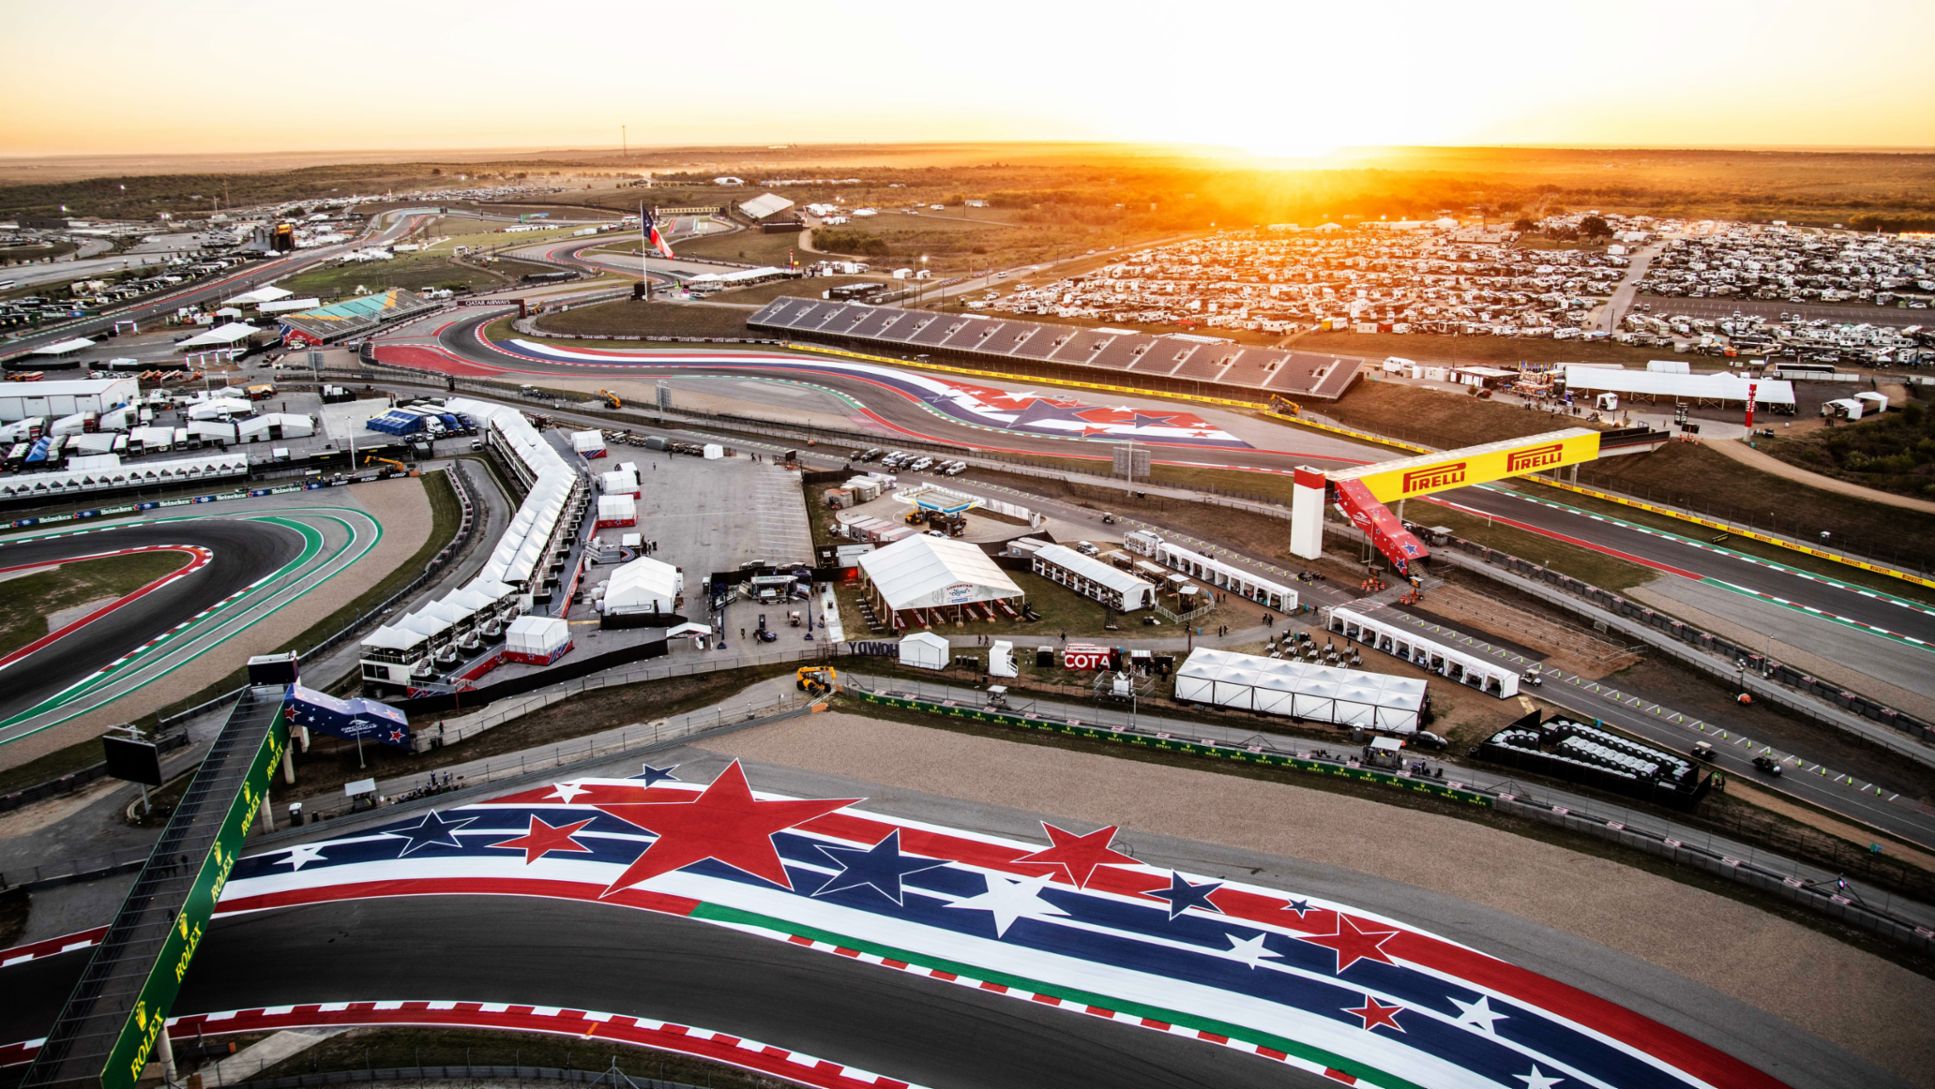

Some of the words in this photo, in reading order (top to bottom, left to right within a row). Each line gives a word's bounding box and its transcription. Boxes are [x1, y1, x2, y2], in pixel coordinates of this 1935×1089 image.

[1403, 462, 1467, 494] PIRELLI
[1507, 443, 1563, 473] PIRELLI
[1064, 654, 1111, 669] COTA
[267, 741, 284, 781] ROLEX
[241, 792, 261, 837] ROLEX
[211, 850, 234, 903] ROLEX
[175, 921, 202, 984] ROLEX
[130, 1006, 165, 1082] ROLEX
